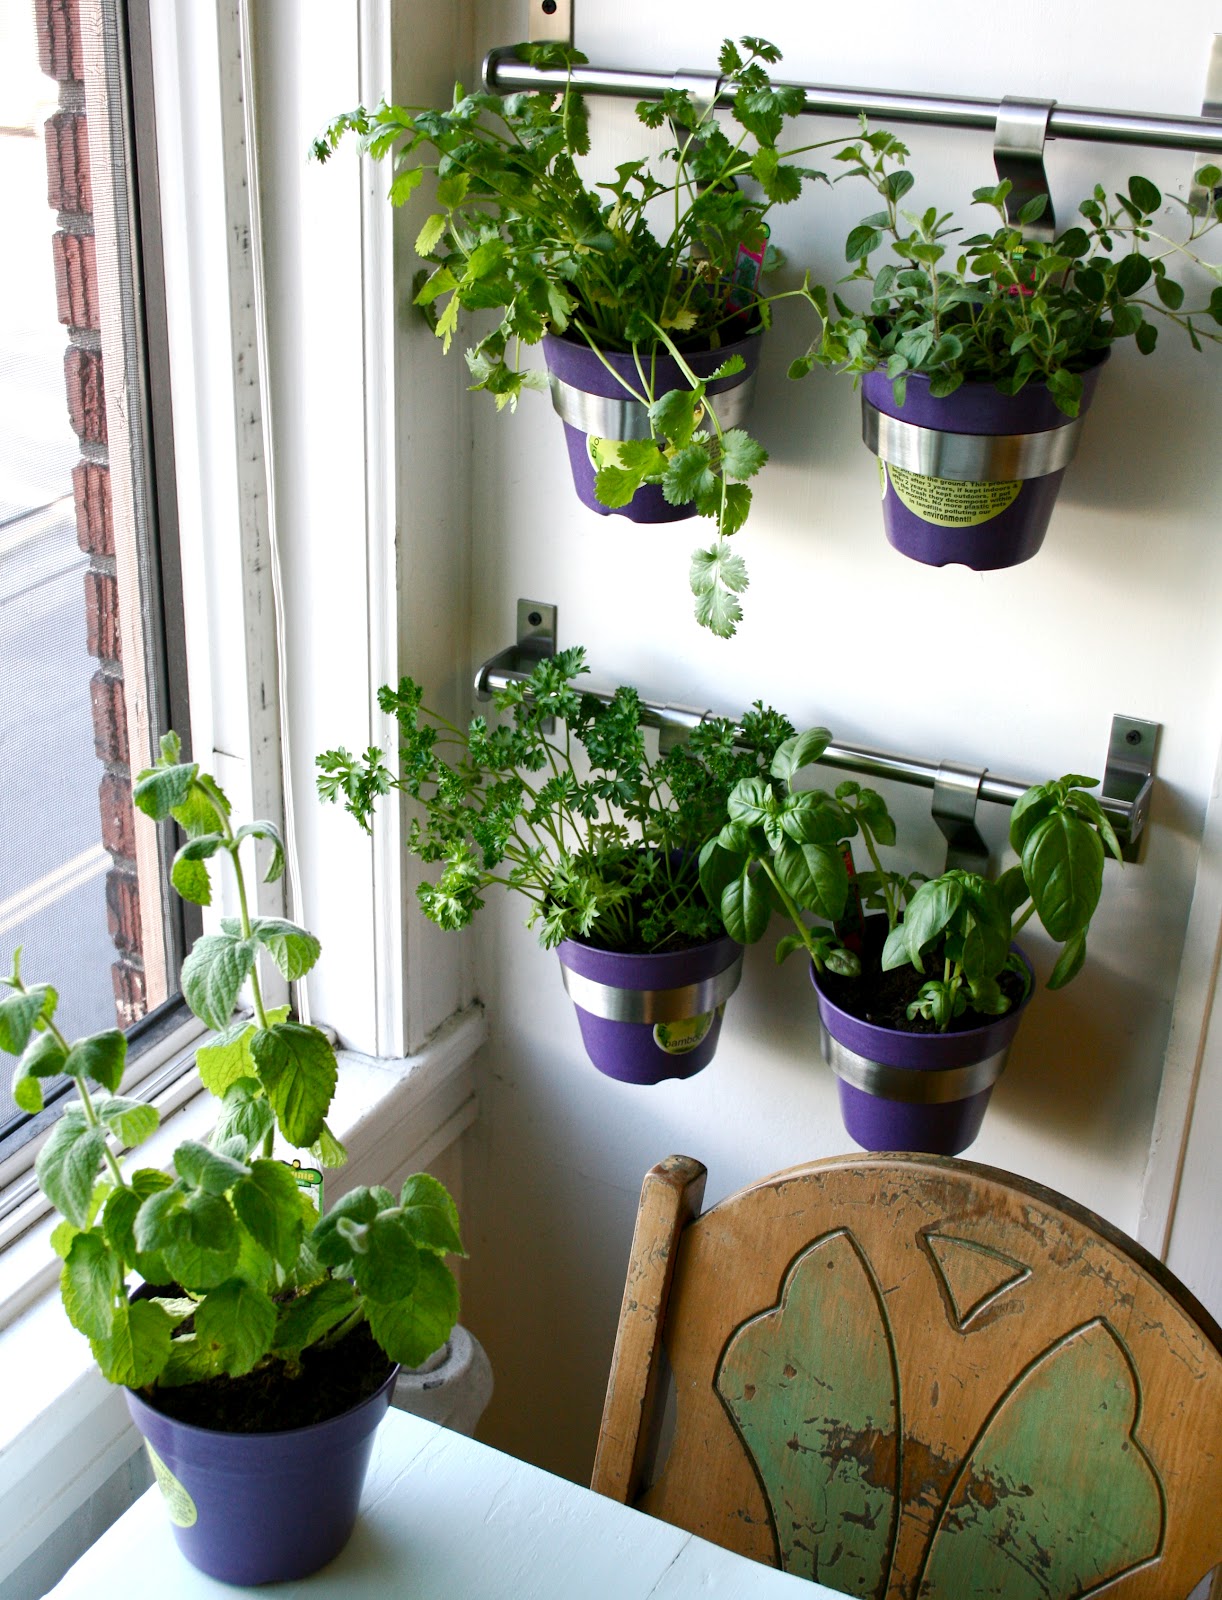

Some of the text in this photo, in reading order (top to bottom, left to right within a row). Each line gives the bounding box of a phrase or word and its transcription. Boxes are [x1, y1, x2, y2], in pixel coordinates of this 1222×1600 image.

[910, 477, 925, 486] after
[933, 485, 955, 494] years,
[940, 480, 968, 488] ground.
[906, 491, 931, 504] months.
[910, 484, 927, 492] years
[936, 490, 952, 498] kept
[911, 487, 928, 498] trash
[928, 494, 944, 502] they
[990, 496, 1012, 504] within
[916, 500, 943, 512] landfills
